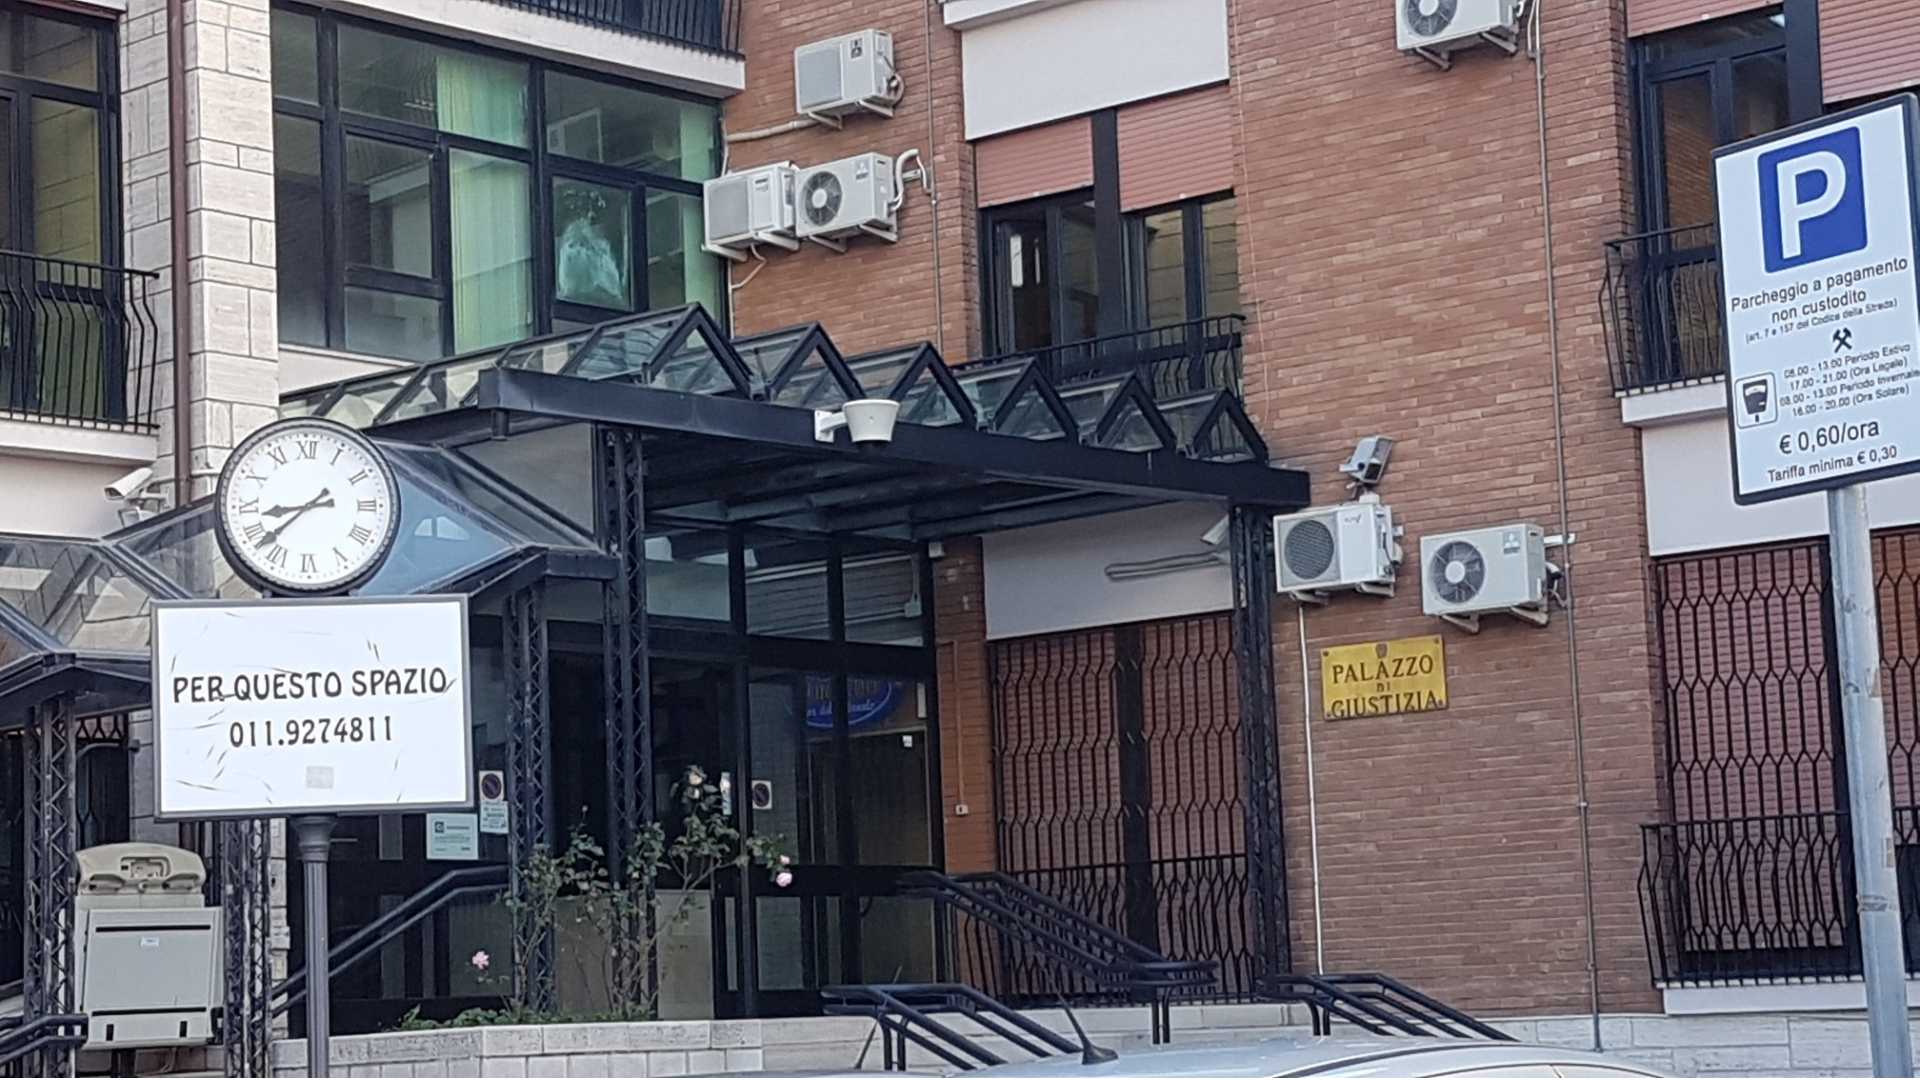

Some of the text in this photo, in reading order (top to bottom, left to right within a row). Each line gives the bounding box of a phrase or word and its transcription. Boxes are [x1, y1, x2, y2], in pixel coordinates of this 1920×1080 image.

[1776, 150, 1847, 260] P
[1731, 258, 1908, 312] Parcheggio a pagamento
[1772, 289, 1866, 323] non custodito
[1844, 351, 1880, 365] Periodo
[1882, 344, 1911, 357] Estivo
[1790, 377, 1814, 391] 17.00
[1850, 366, 1870, 380] (Ora
[1872, 356, 1908, 372] Legale)
[1840, 379, 1875, 393] Periodo
[1853, 393, 1873, 406] (Ora
[1875, 383, 1910, 399] Solare)
[1779, 420, 1880, 455] € 0,60/ora
[1767, 445, 1898, 482] Tariffa minima € 0,30
[173, 667, 447, 703] PER QUESTO SPAZIO
[1332, 654, 1434, 684] PALAZZO
[1376, 682, 1391, 693] DI
[1331, 690, 1439, 719] GIUSTIZIA
[229, 715, 392, 748] 011.9274811
